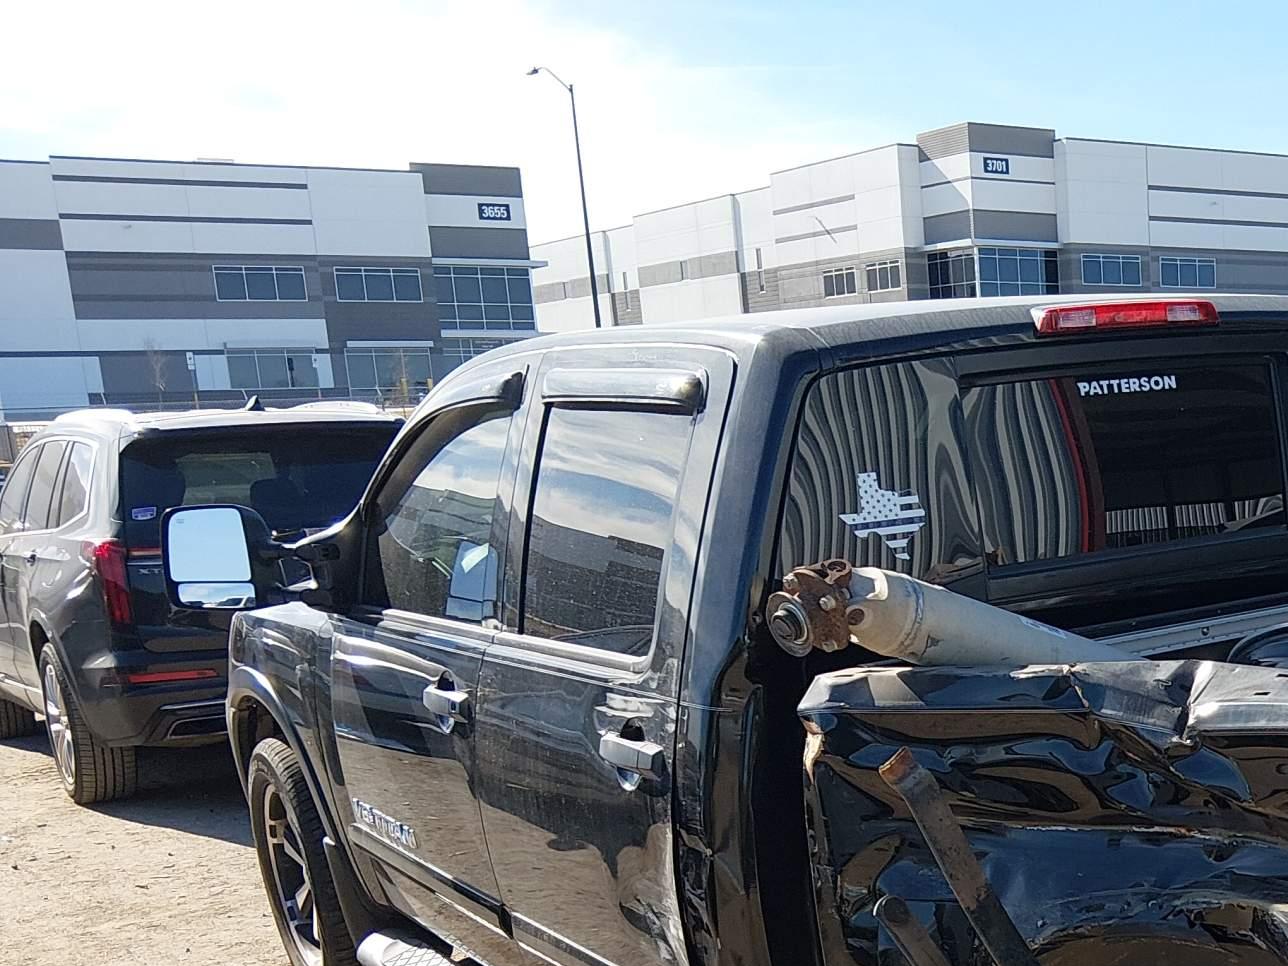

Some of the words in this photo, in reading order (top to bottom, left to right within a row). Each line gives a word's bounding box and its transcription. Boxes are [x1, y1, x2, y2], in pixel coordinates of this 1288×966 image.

[986, 159, 1007, 172] 3701
[481, 205, 508, 218] 3655
[1077, 375, 1177, 396] PATTERSON
[138, 567, 161, 575] XT
